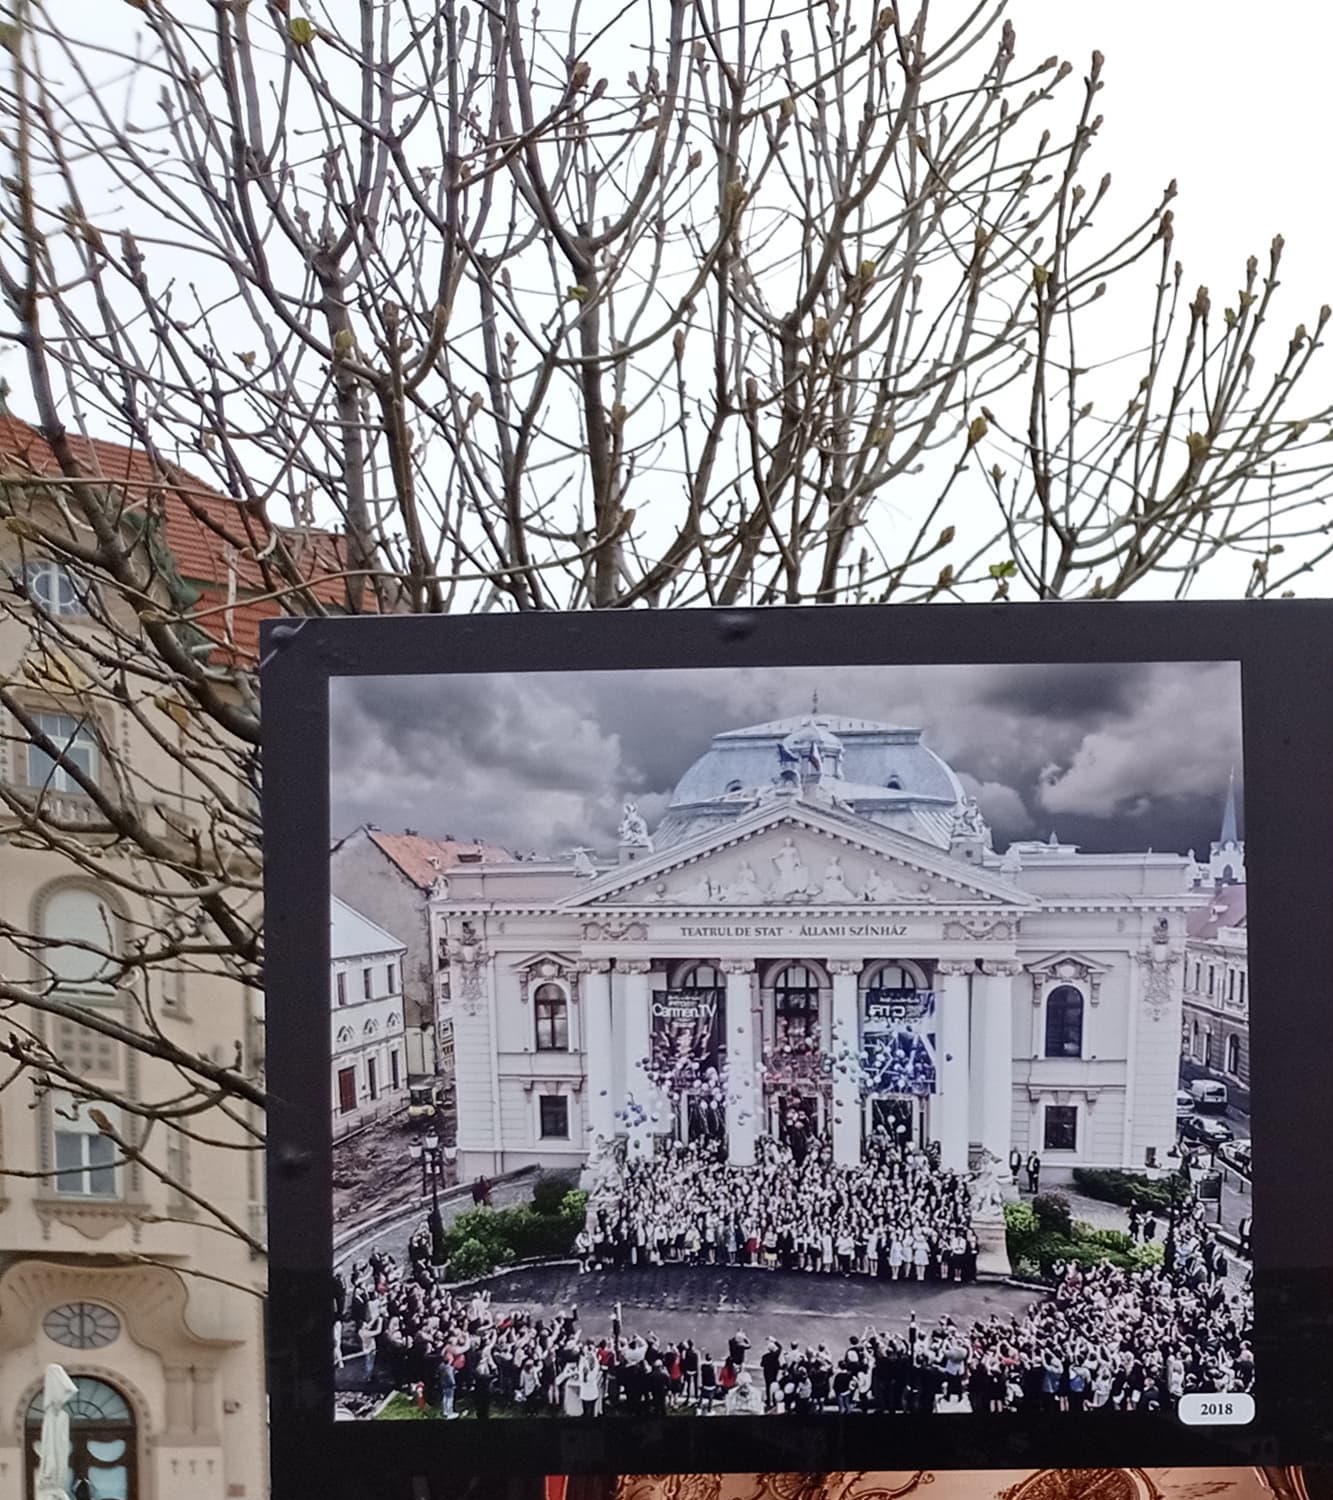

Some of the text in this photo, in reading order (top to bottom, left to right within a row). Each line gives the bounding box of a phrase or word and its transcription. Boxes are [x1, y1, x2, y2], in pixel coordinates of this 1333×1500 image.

[680, 927, 733, 937] TEATRUL
[735, 927, 752, 937] DE
[755, 927, 784, 937] STAT
[1200, 1403, 1233, 1415] 2018
